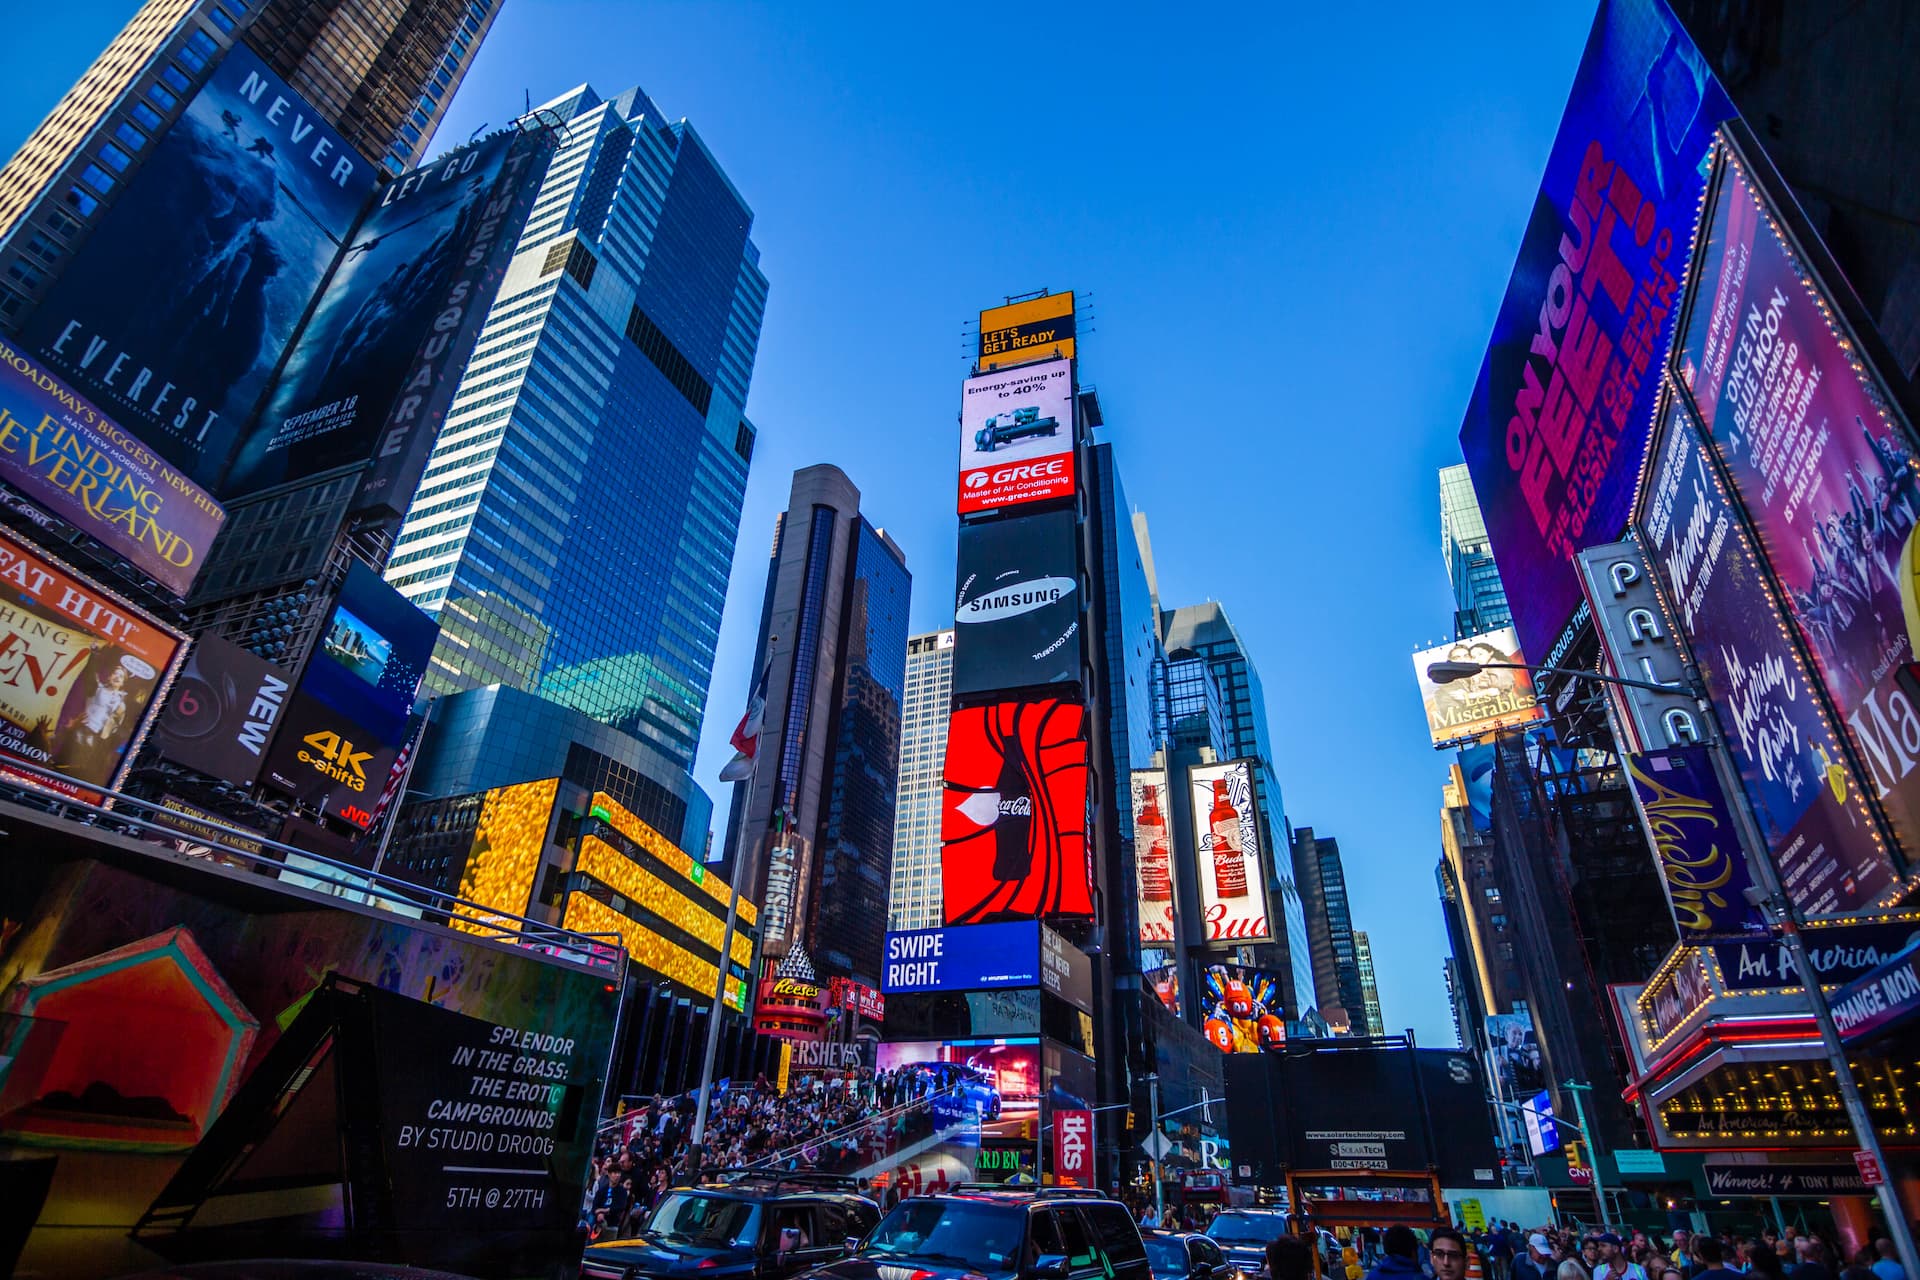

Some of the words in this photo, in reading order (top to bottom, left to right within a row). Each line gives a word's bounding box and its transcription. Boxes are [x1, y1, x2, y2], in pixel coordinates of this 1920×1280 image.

[239, 70, 354, 189] NEVER
[381, 168, 432, 208] LET
[441, 151, 479, 181] GO
[466, 151, 531, 267] TIMES
[1731, 242, 1749, 288] Year!
[1506, 360, 1545, 471] ON
[1529, 139, 1615, 366] YOUR
[1703, 332, 1717, 374] TIME
[1711, 244, 1738, 334] Magazine's
[1725, 291, 1739, 320] the
[1743, 302, 1764, 340] IN
[984, 327, 1018, 344] LET'S
[984, 341, 1009, 355] GET
[1013, 329, 1056, 349] READY
[1721, 317, 1733, 338] of
[379, 280, 472, 457] SQUARE
[1519, 164, 1657, 538] FEET!
[1711, 338, 1729, 380] Show
[1761, 335, 1786, 392] COMES
[52, 319, 219, 442] EVEREST
[968, 372, 1048, 396] Energy-saving
[1051, 369, 1066, 381] up
[998, 389, 1010, 399] to
[1013, 382, 1046, 396] 40%
[1547, 490, 1572, 559] THE
[1566, 418, 1604, 497] STORY
[1599, 362, 1623, 408] OF
[1623, 228, 1673, 357] EMILIO
[280, 400, 341, 433] SEPTEMBER
[341, 394, 359, 413] 18
[1567, 430, 1615, 540] GLORIA
[1612, 272, 1678, 427] ESTEFAN
[1732, 372, 1761, 434] BLUE
[1748, 388, 1768, 436] SHOW
[1749, 437, 1765, 469] OUT
[1759, 376, 1788, 442] BLAZING
[1781, 341, 1800, 379] AND
[1745, 430, 1752, 446] A
[1758, 409, 1790, 478] RESTORES
[1783, 367, 1805, 413] YOUR
[1762, 462, 1783, 507] FAITH
[1776, 447, 1788, 468] IN
[1783, 362, 1823, 452] BROADWAY.
[63, 413, 111, 450] MATTHEW
[110, 449, 157, 485] MORRISON
[1729, 434, 1739, 454] A
[1782, 425, 1813, 491] MATILDA
[36, 413, 164, 515] FINDING
[100, 420, 161, 472] BIGGEST
[160, 467, 193, 497] NEW
[193, 495, 224, 521] HIT!
[993, 459, 1065, 484] GREE
[364, 478, 388, 491] NYC
[963, 486, 991, 499] Master
[993, 485, 1002, 494] of
[1003, 483, 1015, 493] Air
[1016, 475, 1069, 491] Conditioning
[981, 487, 1052, 506] www.gree.com
[1786, 469, 1809, 510] THAT
[1665, 453, 1713, 606] Winner!
[1782, 506, 1794, 524] IS
[1698, 556, 1714, 597] TONY
[1706, 510, 1729, 570] AWARDS
[970, 588, 1060, 612] SAMSUNG
[1720, 645, 1746, 697] An
[237, 673, 289, 756] NEW
[1432, 694, 1537, 730] Misérables
[1463, 691, 1492, 708] Les
[1728, 652, 1796, 761] American
[303, 730, 375, 780] 4K
[1758, 705, 1801, 782] Paris
[297, 749, 366, 792] e-shift3
[340, 804, 371, 828] JVC
[765, 846, 794, 942] HERSHEY'S
[1042, 927, 1052, 942] THE
[1053, 935, 1063, 951] CAR
[1741, 921, 1764, 931] Disney
[889, 934, 944, 959] SWIPE
[1739, 944, 1771, 980] An
[888, 962, 941, 987] RIGHT.
[1042, 967, 1062, 991] SLEEPS.
[1043, 952, 1054, 968] THAT
[1055, 955, 1071, 978] NEVER
[773, 978, 820, 997] Reese's
[1831, 983, 1888, 1033] CHANGE
[489, 1026, 575, 1056] SPLENDOR
[791, 1039, 862, 1069] ERSHEY'S
[452, 1046, 476, 1067] IN
[477, 1050, 513, 1072] THE
[512, 1055, 569, 1080] GRASS:
[469, 1076, 506, 1098] THE
[505, 1082, 561, 1105] EROTIC
[427, 1100, 555, 1129] CAMPGROUNDS
[1698, 1113, 1713, 1131] An
[1718, 1111, 1779, 1131] American
[398, 1125, 425, 1147] BY
[427, 1129, 494, 1152] STUDIO
[498, 1133, 554, 1156] DROOG
[1060, 1116, 1087, 1170] tkts
[1307, 1131, 1406, 1139] www.solartechnology.com
[975, 1151, 1020, 1169] ARDEN
[1332, 1159, 1387, 1169] 800-475-5442
[1711, 1169, 1773, 1190] Winner!
[1779, 1174, 1793, 1190] 4
[1797, 1175, 1830, 1190] TONY
[446, 1187, 482, 1208] 5TH
[484, 1187, 501, 1208] @
[502, 1188, 545, 1209] 27TH
